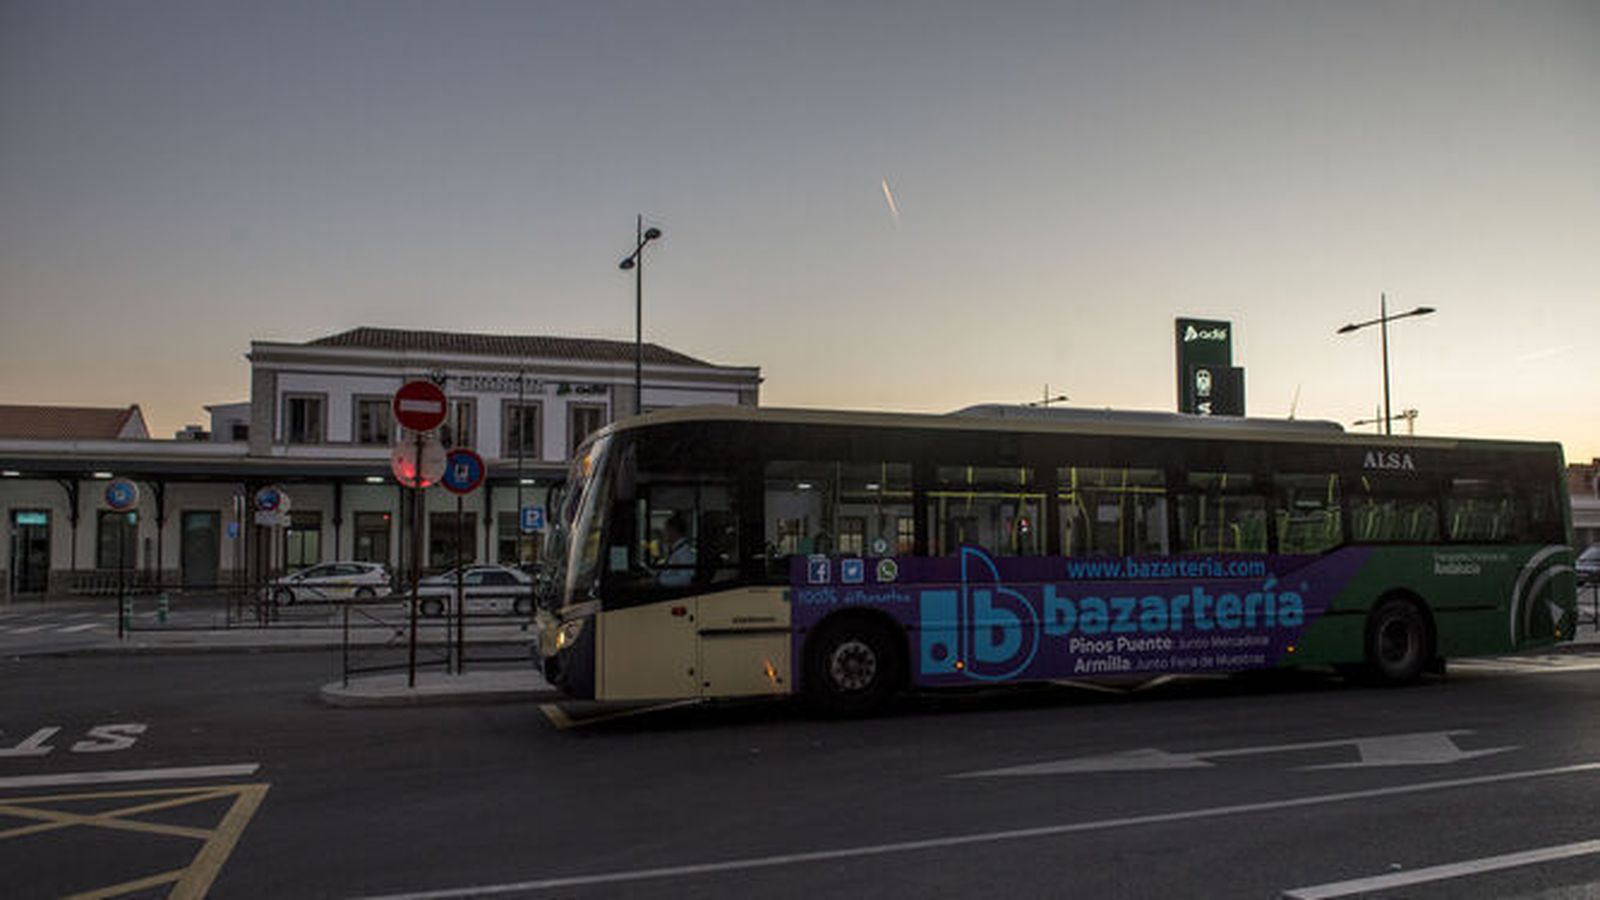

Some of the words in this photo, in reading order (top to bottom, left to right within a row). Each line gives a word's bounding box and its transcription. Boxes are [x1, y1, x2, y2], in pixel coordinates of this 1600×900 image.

[1363, 451, 1415, 470] ALSA
[1066, 556, 1266, 579] www.bazarteria.com
[1042, 574, 1305, 636] bazartería
[1069, 637, 1114, 654] Pinos
[1117, 636, 1172, 652] Puente
[1074, 655, 1131, 673] Armilla
